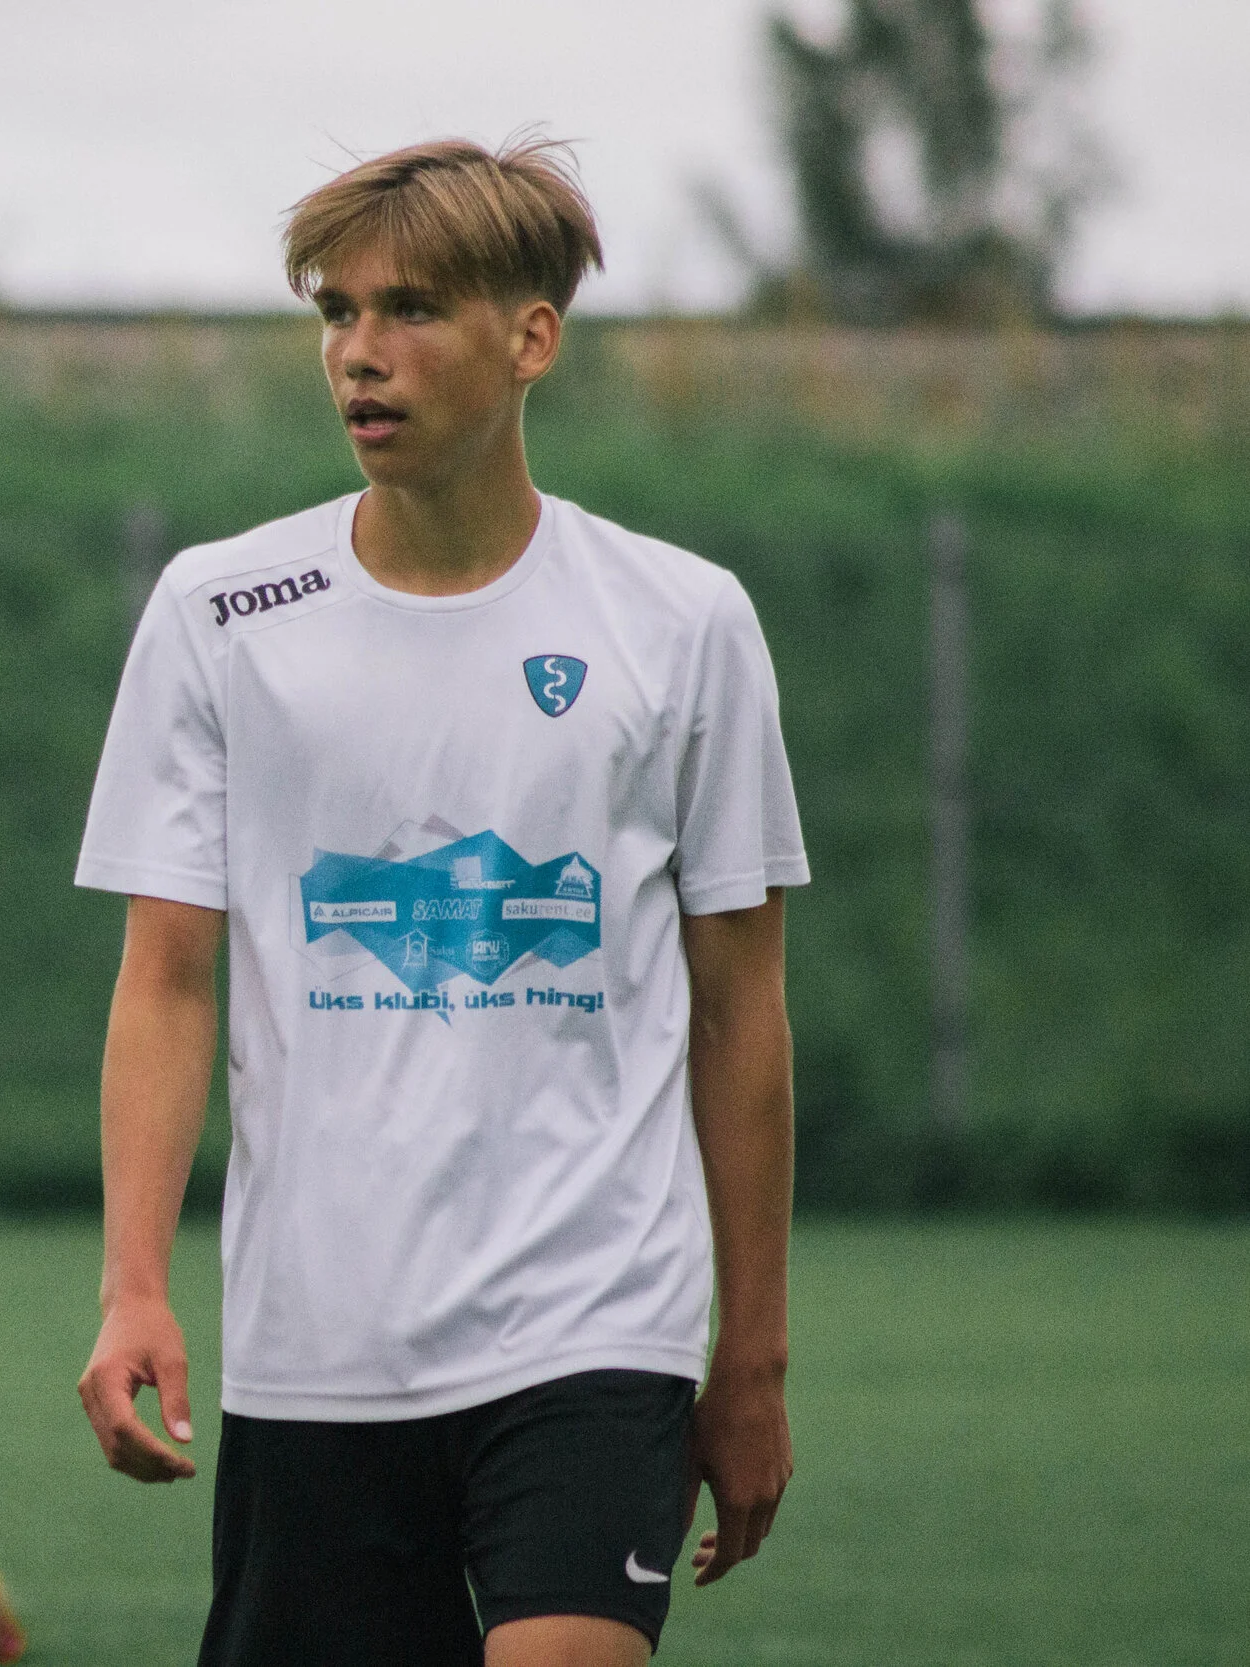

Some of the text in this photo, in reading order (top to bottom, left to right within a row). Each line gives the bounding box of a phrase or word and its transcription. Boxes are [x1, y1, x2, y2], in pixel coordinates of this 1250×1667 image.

[209, 569, 331, 627] Joma
[411, 898, 483, 921] SAMAT
[374, 990, 456, 1012] klubi,
[526, 987, 604, 1013] hing!
